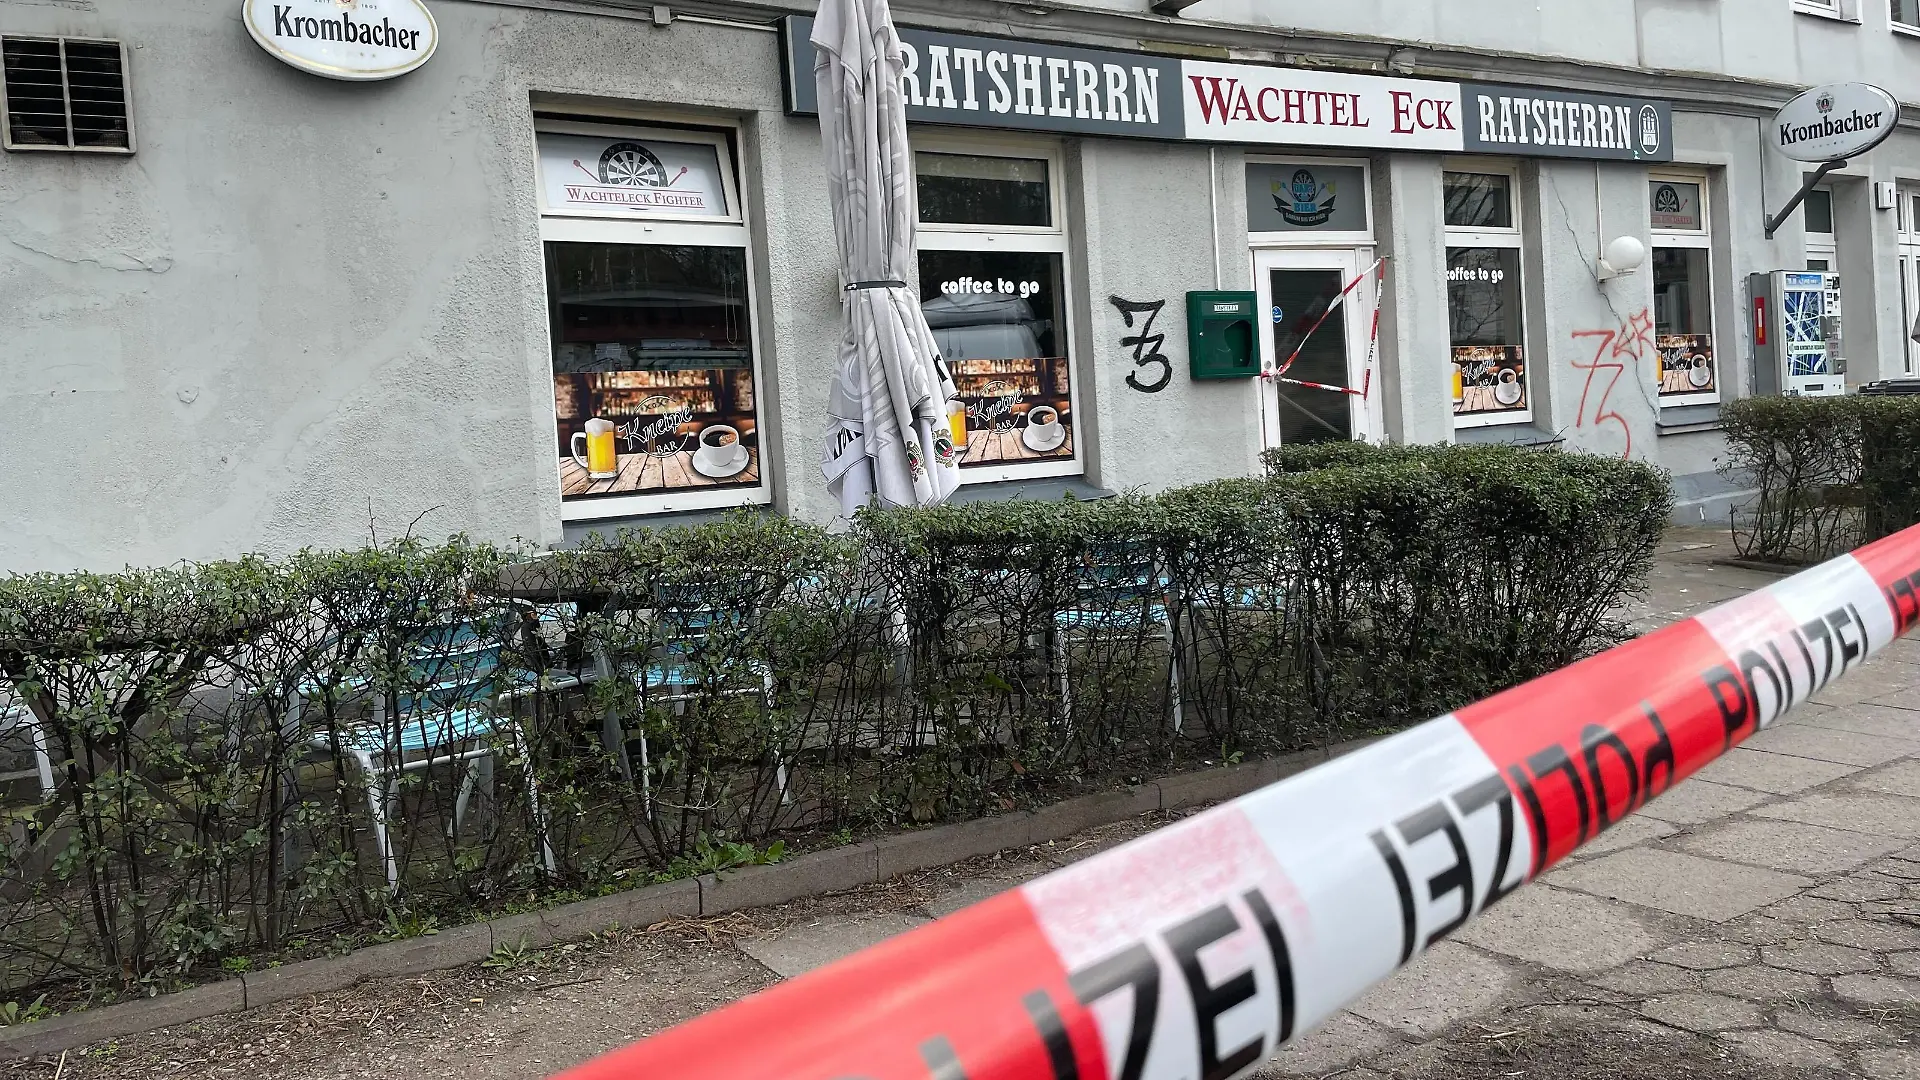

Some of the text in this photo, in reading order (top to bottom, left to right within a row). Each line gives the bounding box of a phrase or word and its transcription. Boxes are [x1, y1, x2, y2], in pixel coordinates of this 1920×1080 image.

[273, 4, 420, 51] Krombacher
[900, 42, 1159, 124] RATSHERRN
[1188, 75, 1456, 134] WACHTEL ECK
[1477, 94, 1632, 150] RATSHERRN
[1780, 109, 1882, 146] Krombacher
[566, 187, 704, 206] WACHTELECK FIGHTER
[1887, 188, 1892, 203] 1
[940, 276, 1040, 299] coffee to go
[1478, 267, 1489, 281] to
[1491, 269, 1504, 284] go
[617, 406, 693, 452] Kneipe
[995, 419, 1013, 431] BAR
[656, 440, 678, 454] BAR
[1700, 602, 1868, 750] POLIZEI
